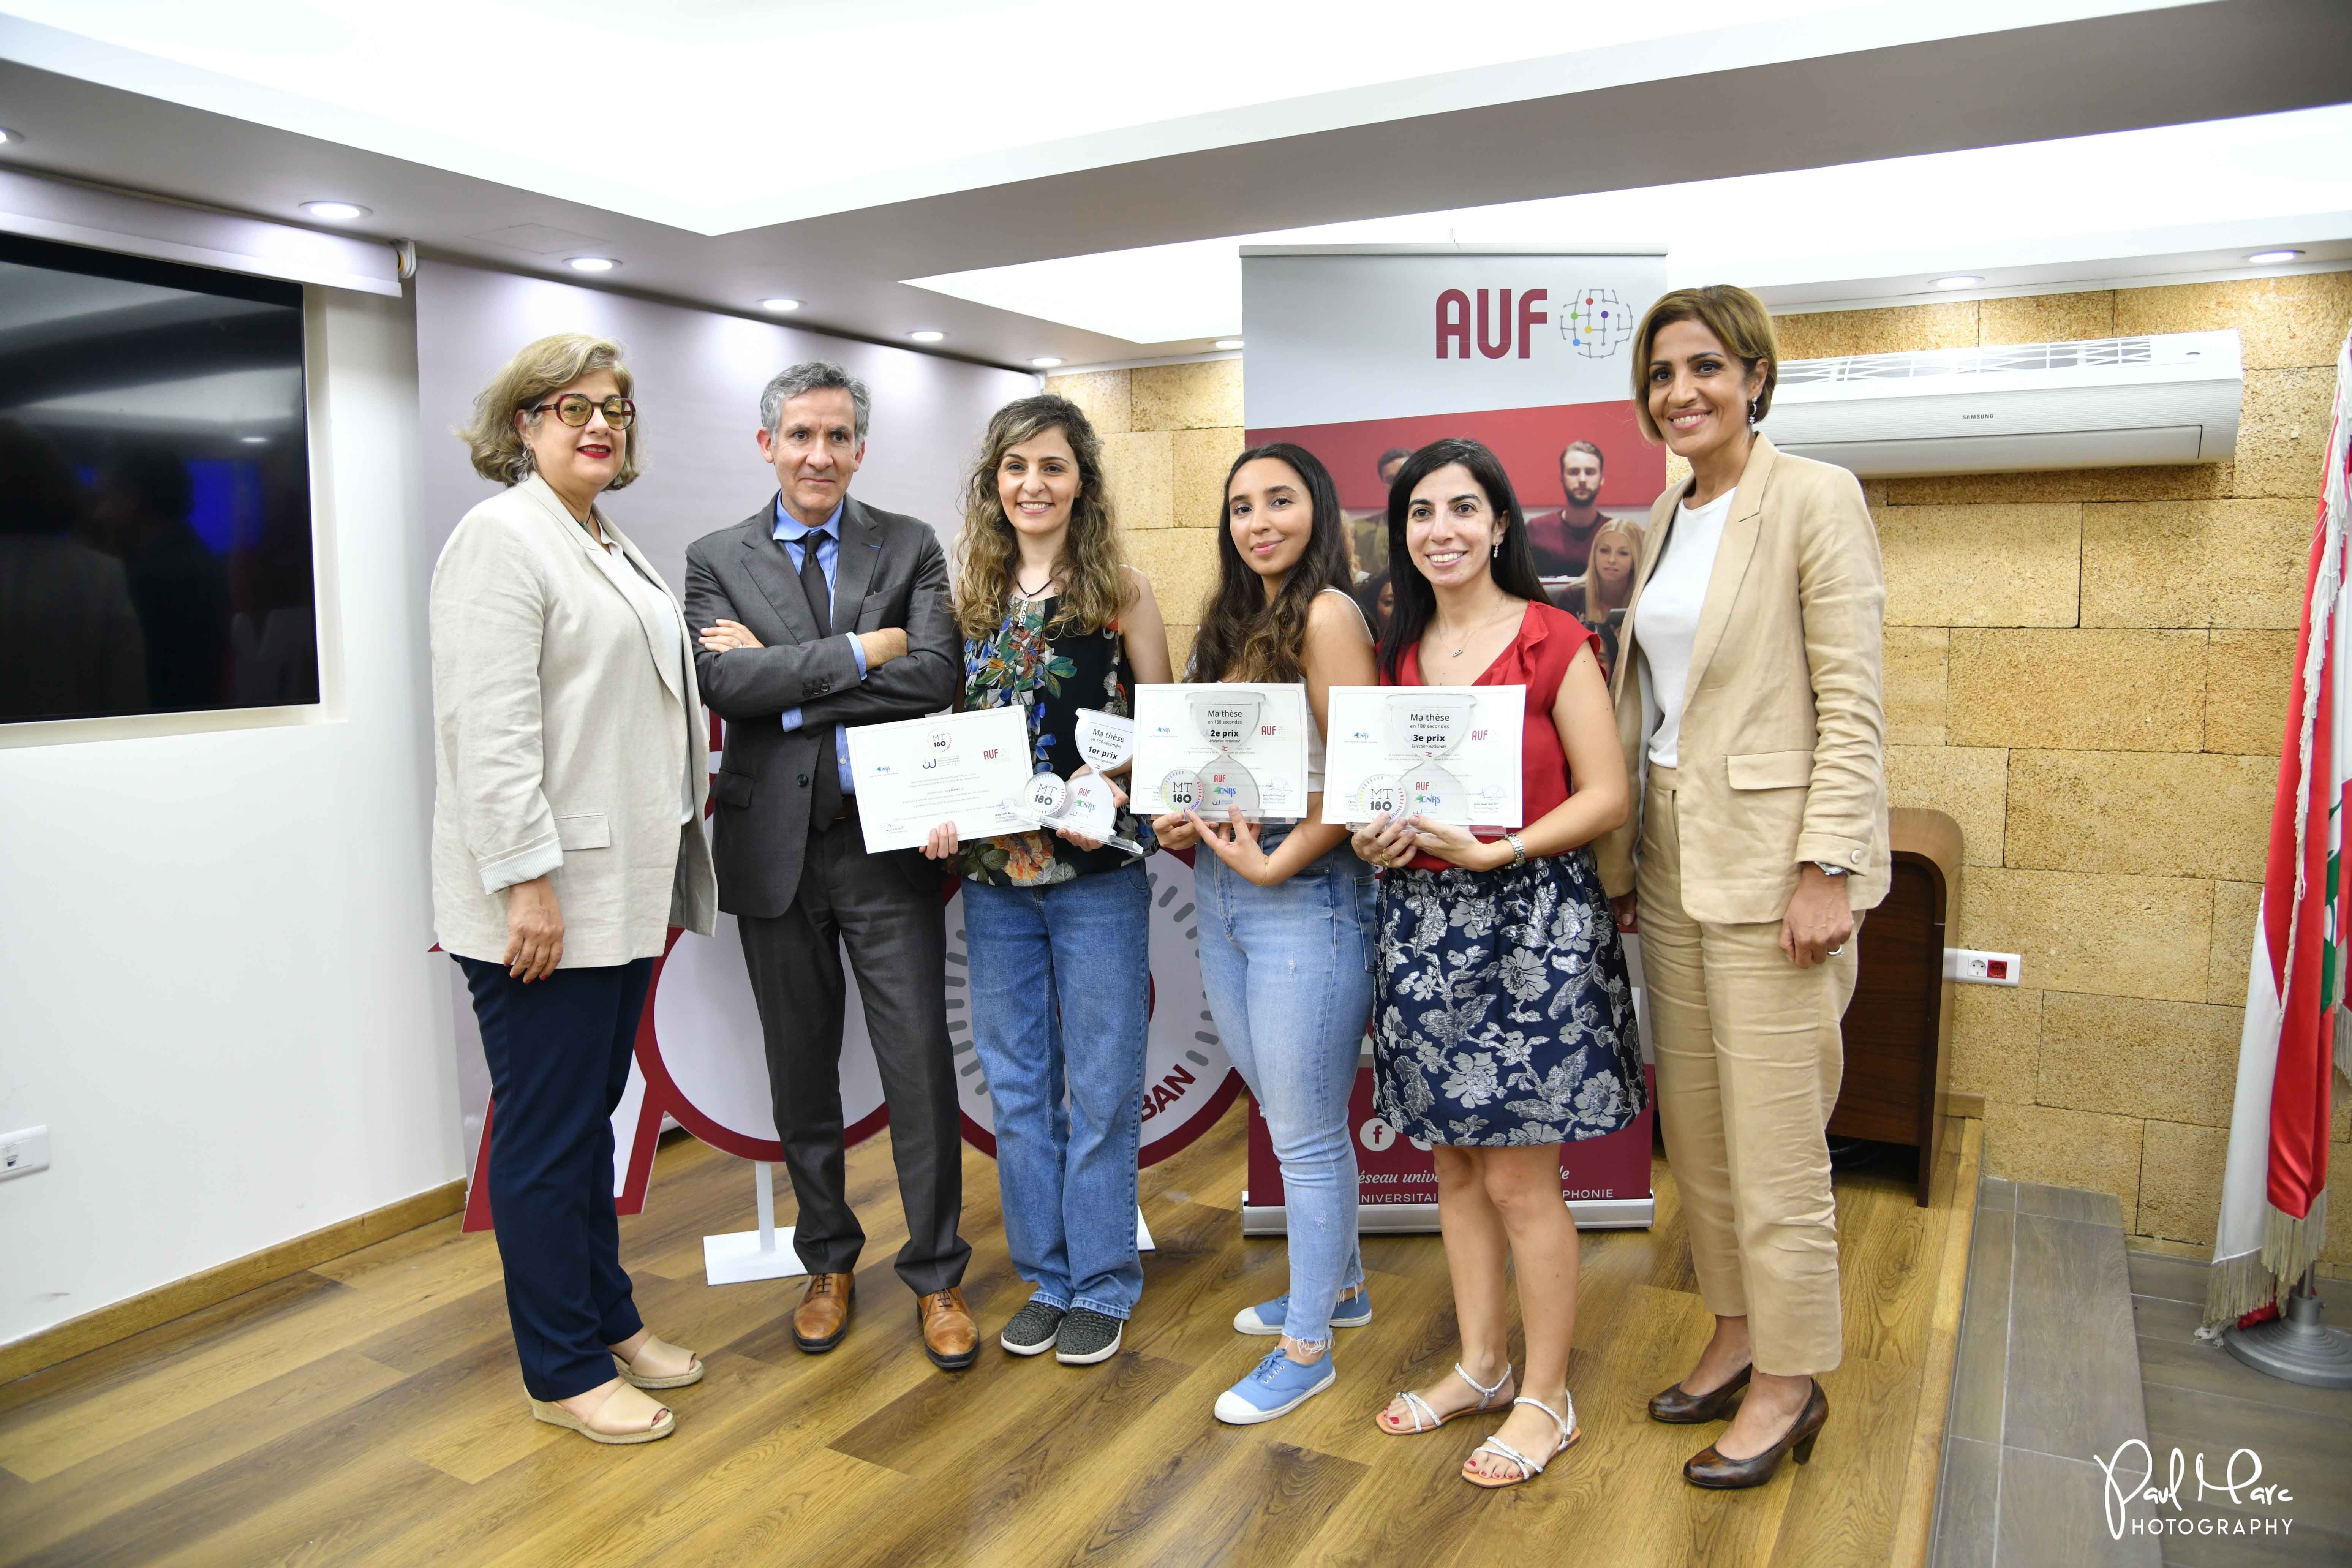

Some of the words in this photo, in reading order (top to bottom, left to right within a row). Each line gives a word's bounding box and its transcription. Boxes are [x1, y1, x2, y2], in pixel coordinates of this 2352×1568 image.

[1436, 288, 1547, 359] AUF
[1092, 728, 1103, 737] Ma
[1105, 732, 1125, 743] thèse
[1222, 729, 1239, 739] prix
[1261, 726, 1276, 736] AUF
[1471, 730, 1488, 741] AUF
[1426, 734, 1445, 744] prix
[983, 748, 999, 760] AUF
[1088, 746, 1101, 755] 1er
[1101, 750, 1118, 760] prix
[1214, 774, 1226, 783] AUF
[1037, 783, 1057, 796] MT
[1173, 782, 1192, 793] MT
[1415, 781, 1430, 790] AUF
[1078, 787, 1091, 797] AUF
[1370, 788, 1393, 800] MT
[1034, 794, 1053, 806] 180
[1173, 794, 1192, 803] 180
[1370, 801, 1392, 811] 180
[1141, 1063, 1196, 1123] BAN
[1359, 1170, 1398, 1184] éseau
[1361, 1193, 1436, 1203] NIVERSITAI
[1563, 1189, 1614, 1199] PHONIE
